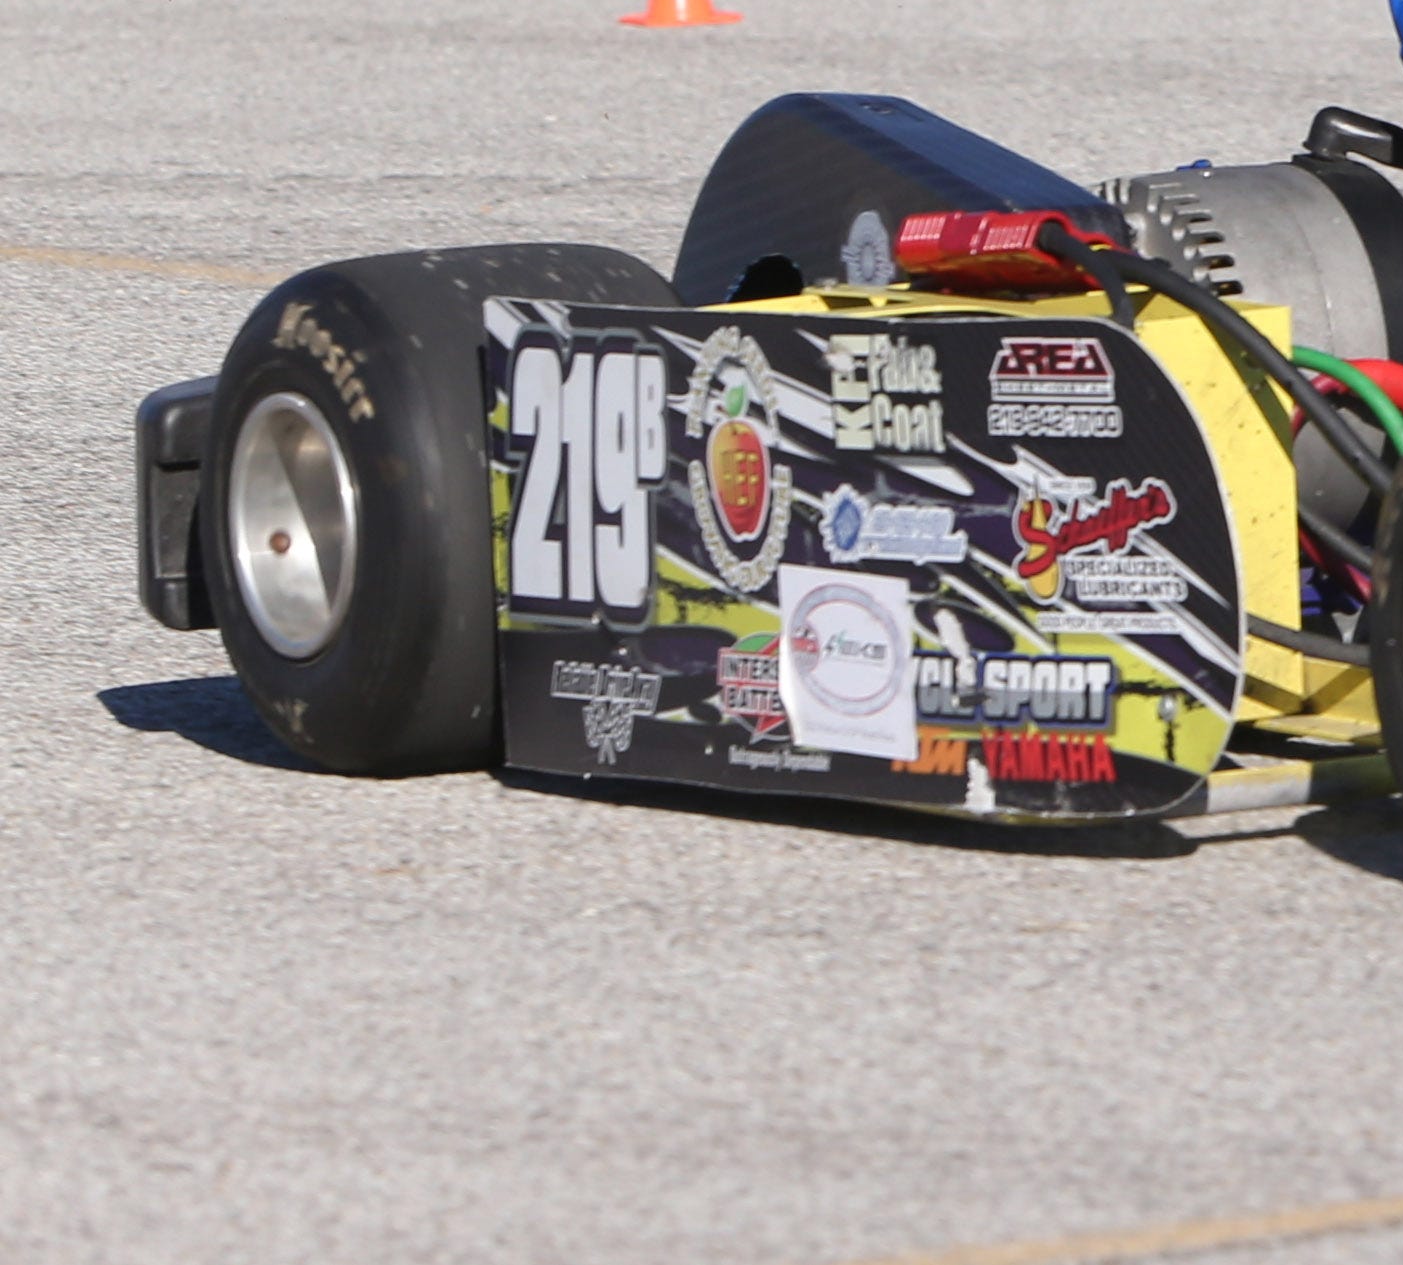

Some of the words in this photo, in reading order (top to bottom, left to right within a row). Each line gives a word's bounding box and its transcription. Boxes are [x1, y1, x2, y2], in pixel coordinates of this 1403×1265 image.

[871, 393, 947, 454] Coat
[981, 660, 1112, 721] SPORT
[981, 730, 1118, 783] YAMAHA
